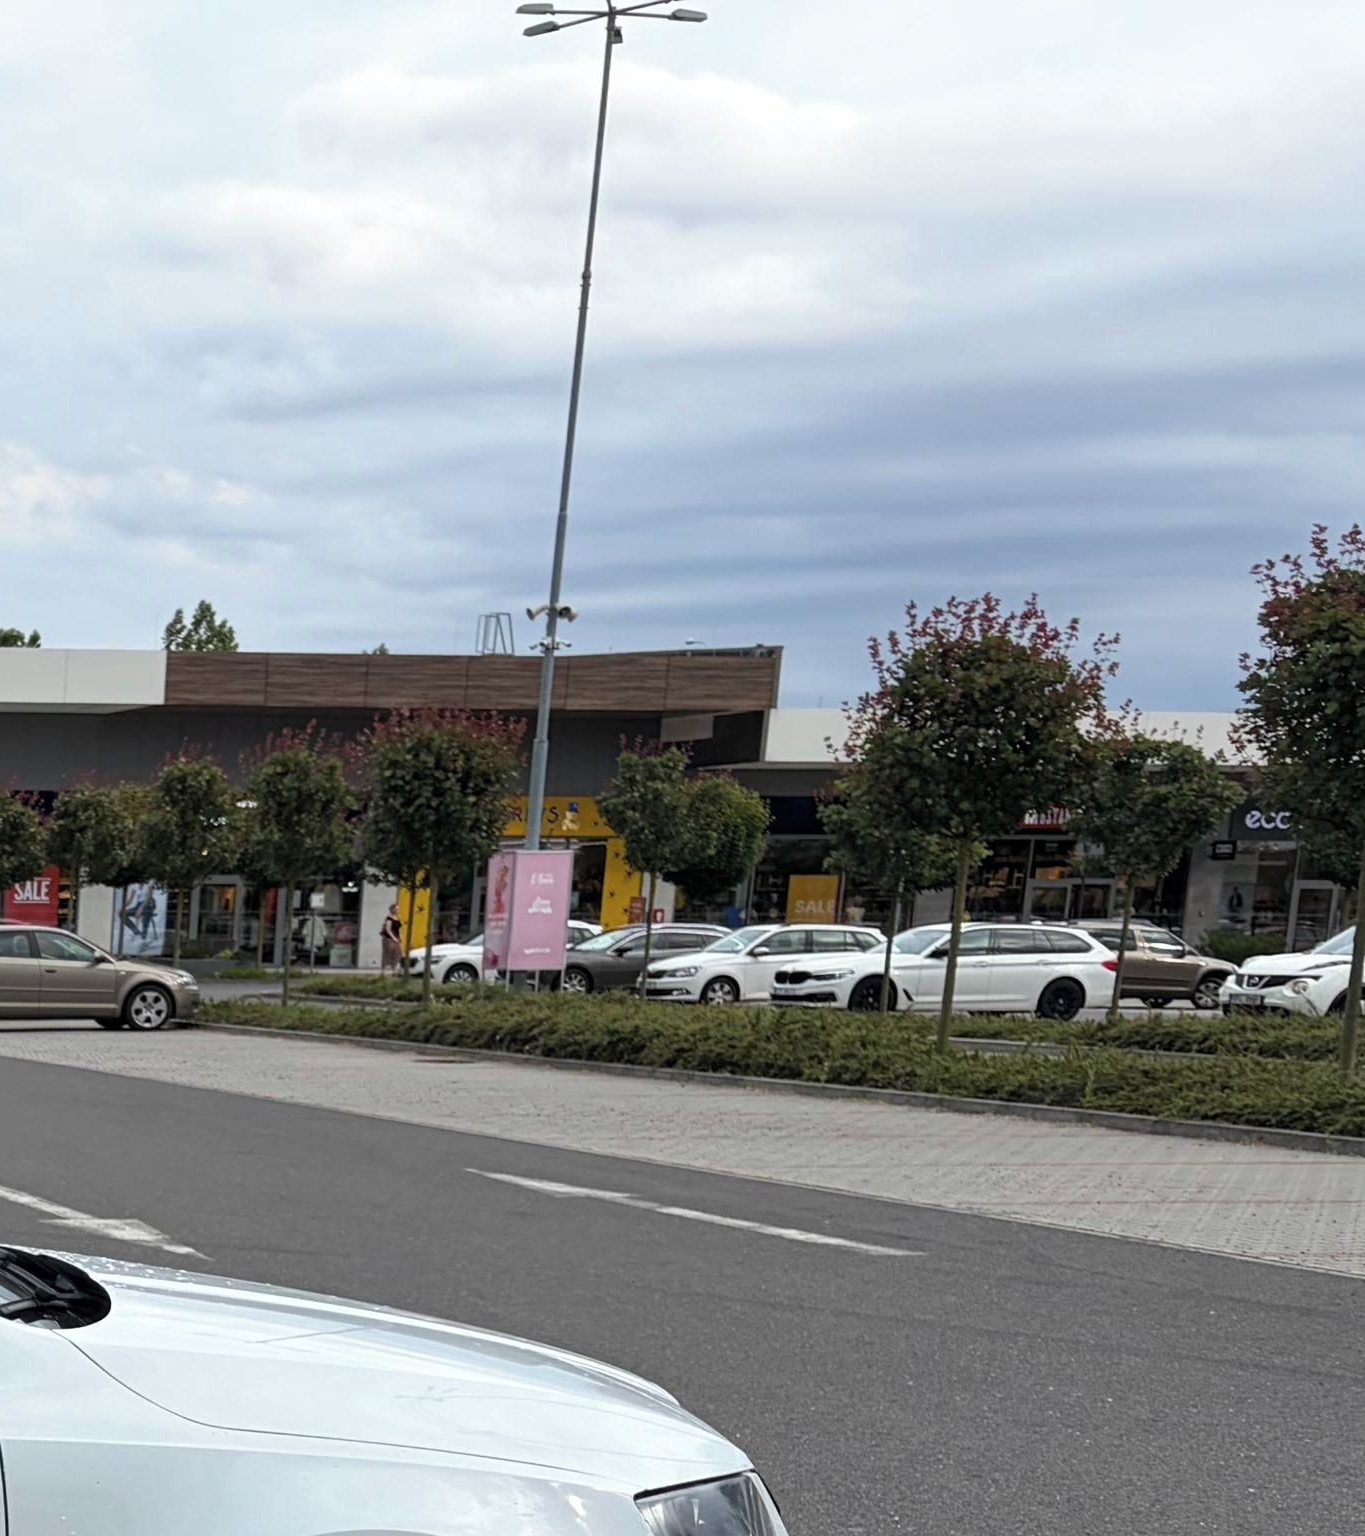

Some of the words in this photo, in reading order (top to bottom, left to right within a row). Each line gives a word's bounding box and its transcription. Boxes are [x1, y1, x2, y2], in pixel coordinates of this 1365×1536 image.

[1245, 809, 1292, 830] ecc
[14, 881, 51, 901] SALE
[796, 899, 836, 913] SALE
